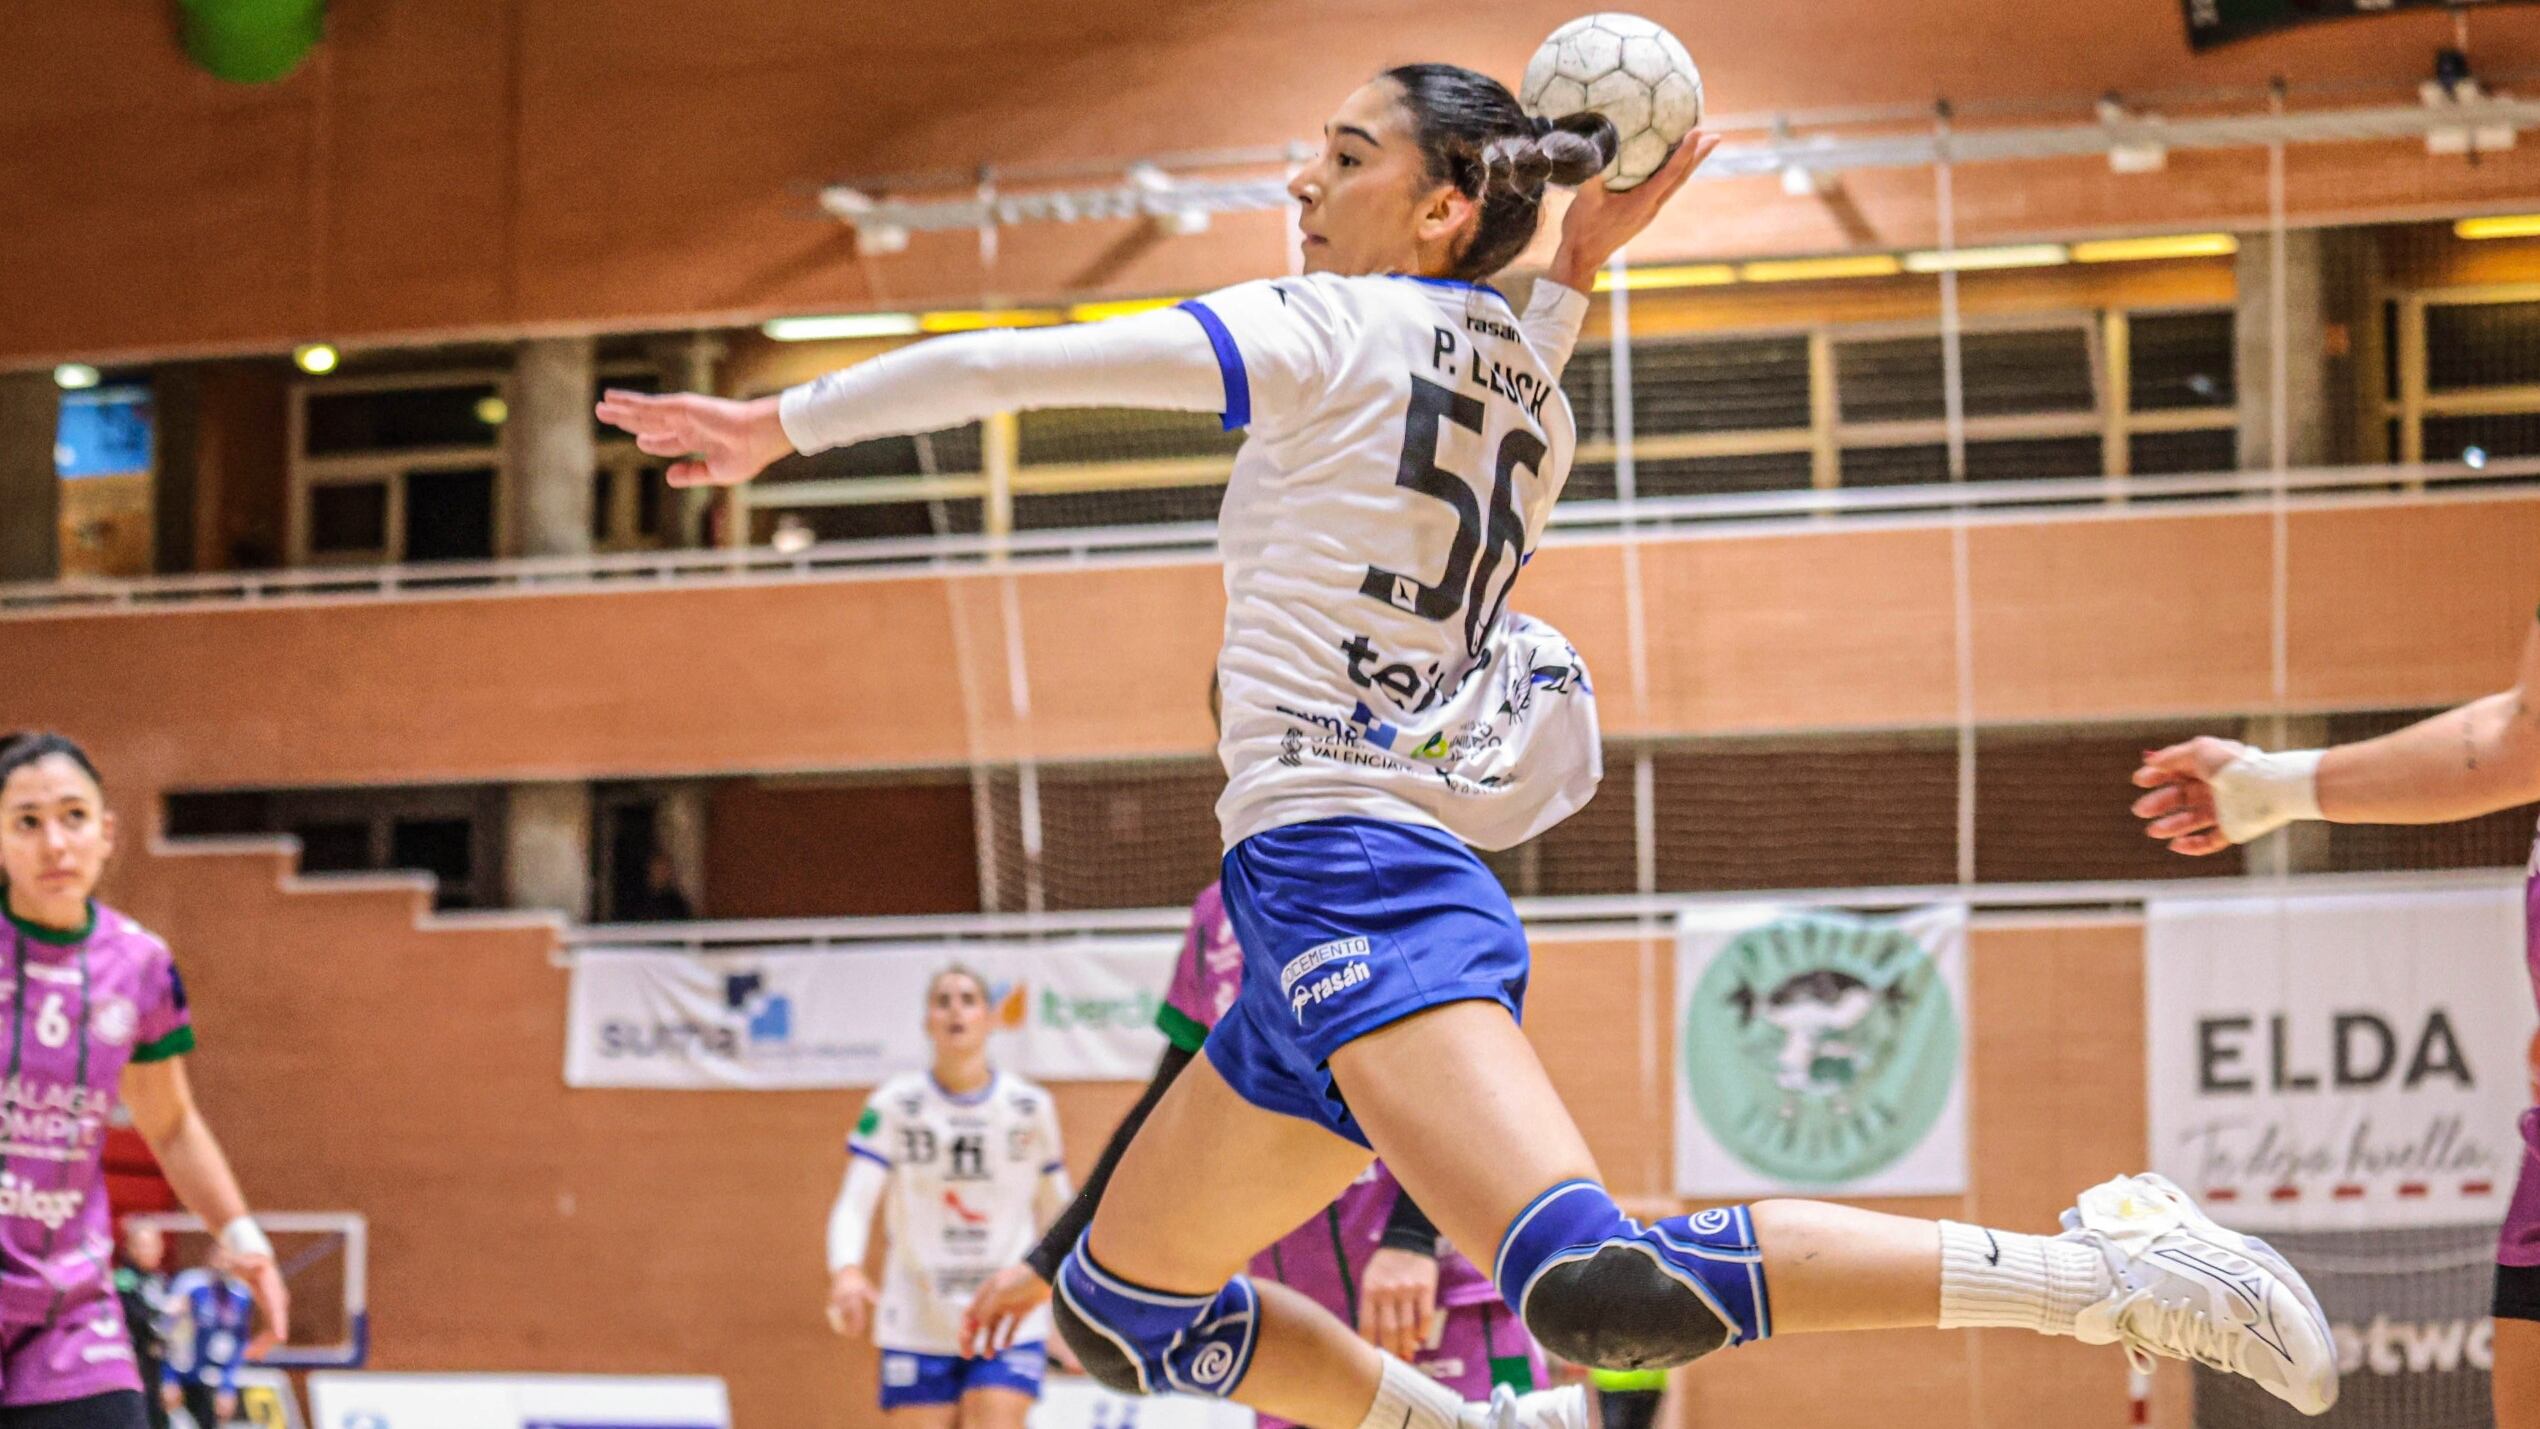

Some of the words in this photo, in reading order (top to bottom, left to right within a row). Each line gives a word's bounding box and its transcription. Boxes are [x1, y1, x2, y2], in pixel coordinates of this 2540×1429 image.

[1432, 325, 1456, 375] P.
[1359, 371, 1548, 659] 56
[1311, 744, 1413, 772] VALENCIA
[1311, 959, 1371, 1005] rasán
[34, 992, 71, 1049] 6
[2195, 1006, 2475, 1096] ELDA
